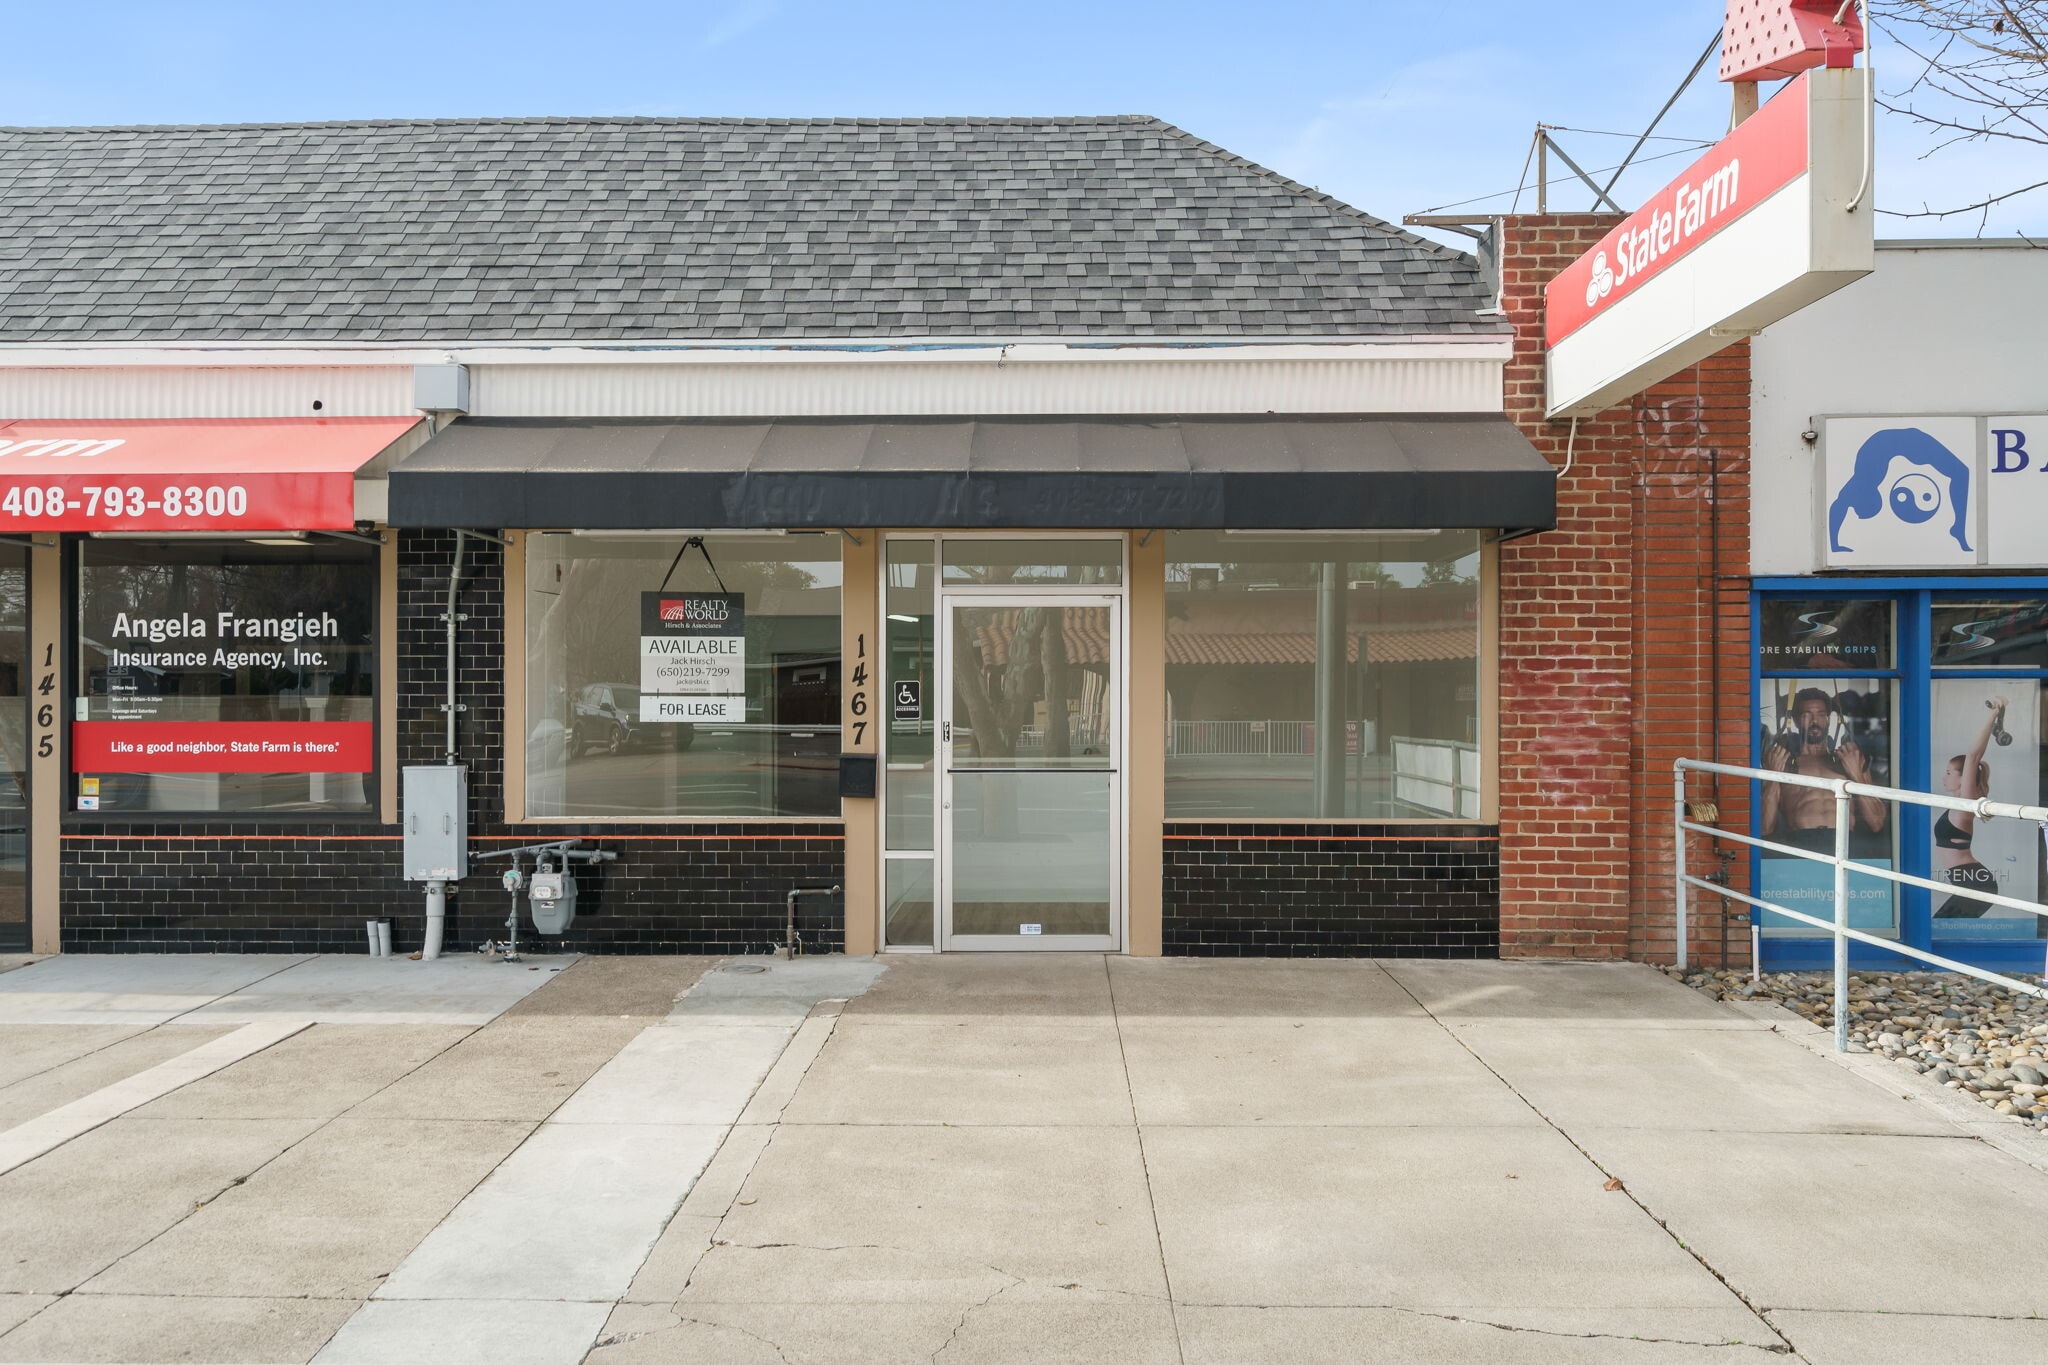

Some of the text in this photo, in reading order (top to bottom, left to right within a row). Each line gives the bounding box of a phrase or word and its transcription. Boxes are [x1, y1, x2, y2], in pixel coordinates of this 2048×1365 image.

[1991, 429, 2048, 473] B
[2, 485, 247, 517] 408-793-8300
[685, 599, 728, 610] REALTY
[685, 610, 729, 621] WORLD
[111, 612, 338, 642] Angela Frangieh
[649, 639, 738, 654] AVAILABLE
[1785, 646, 1840, 654] STABILITY
[1844, 646, 1877, 654] GRIPS
[113, 648, 328, 669] Insurance Agency, Inc.
[670, 657, 716, 665] Jack Hirsch
[656, 667, 730, 678] (650)219-7299
[851, 633, 868, 746] 1467
[37, 643, 55, 758] 1465
[659, 703, 727, 716] FOR LEASE
[111, 742, 134, 753] Like
[136, 744, 143, 753] a
[146, 742, 173, 755] good
[176, 742, 227, 755] neighbor,
[230, 742, 260, 753] State
[262, 742, 290, 753] Farm
[293, 742, 302, 753] is
[1761, 888, 1886, 901] orestabilitygs.com
